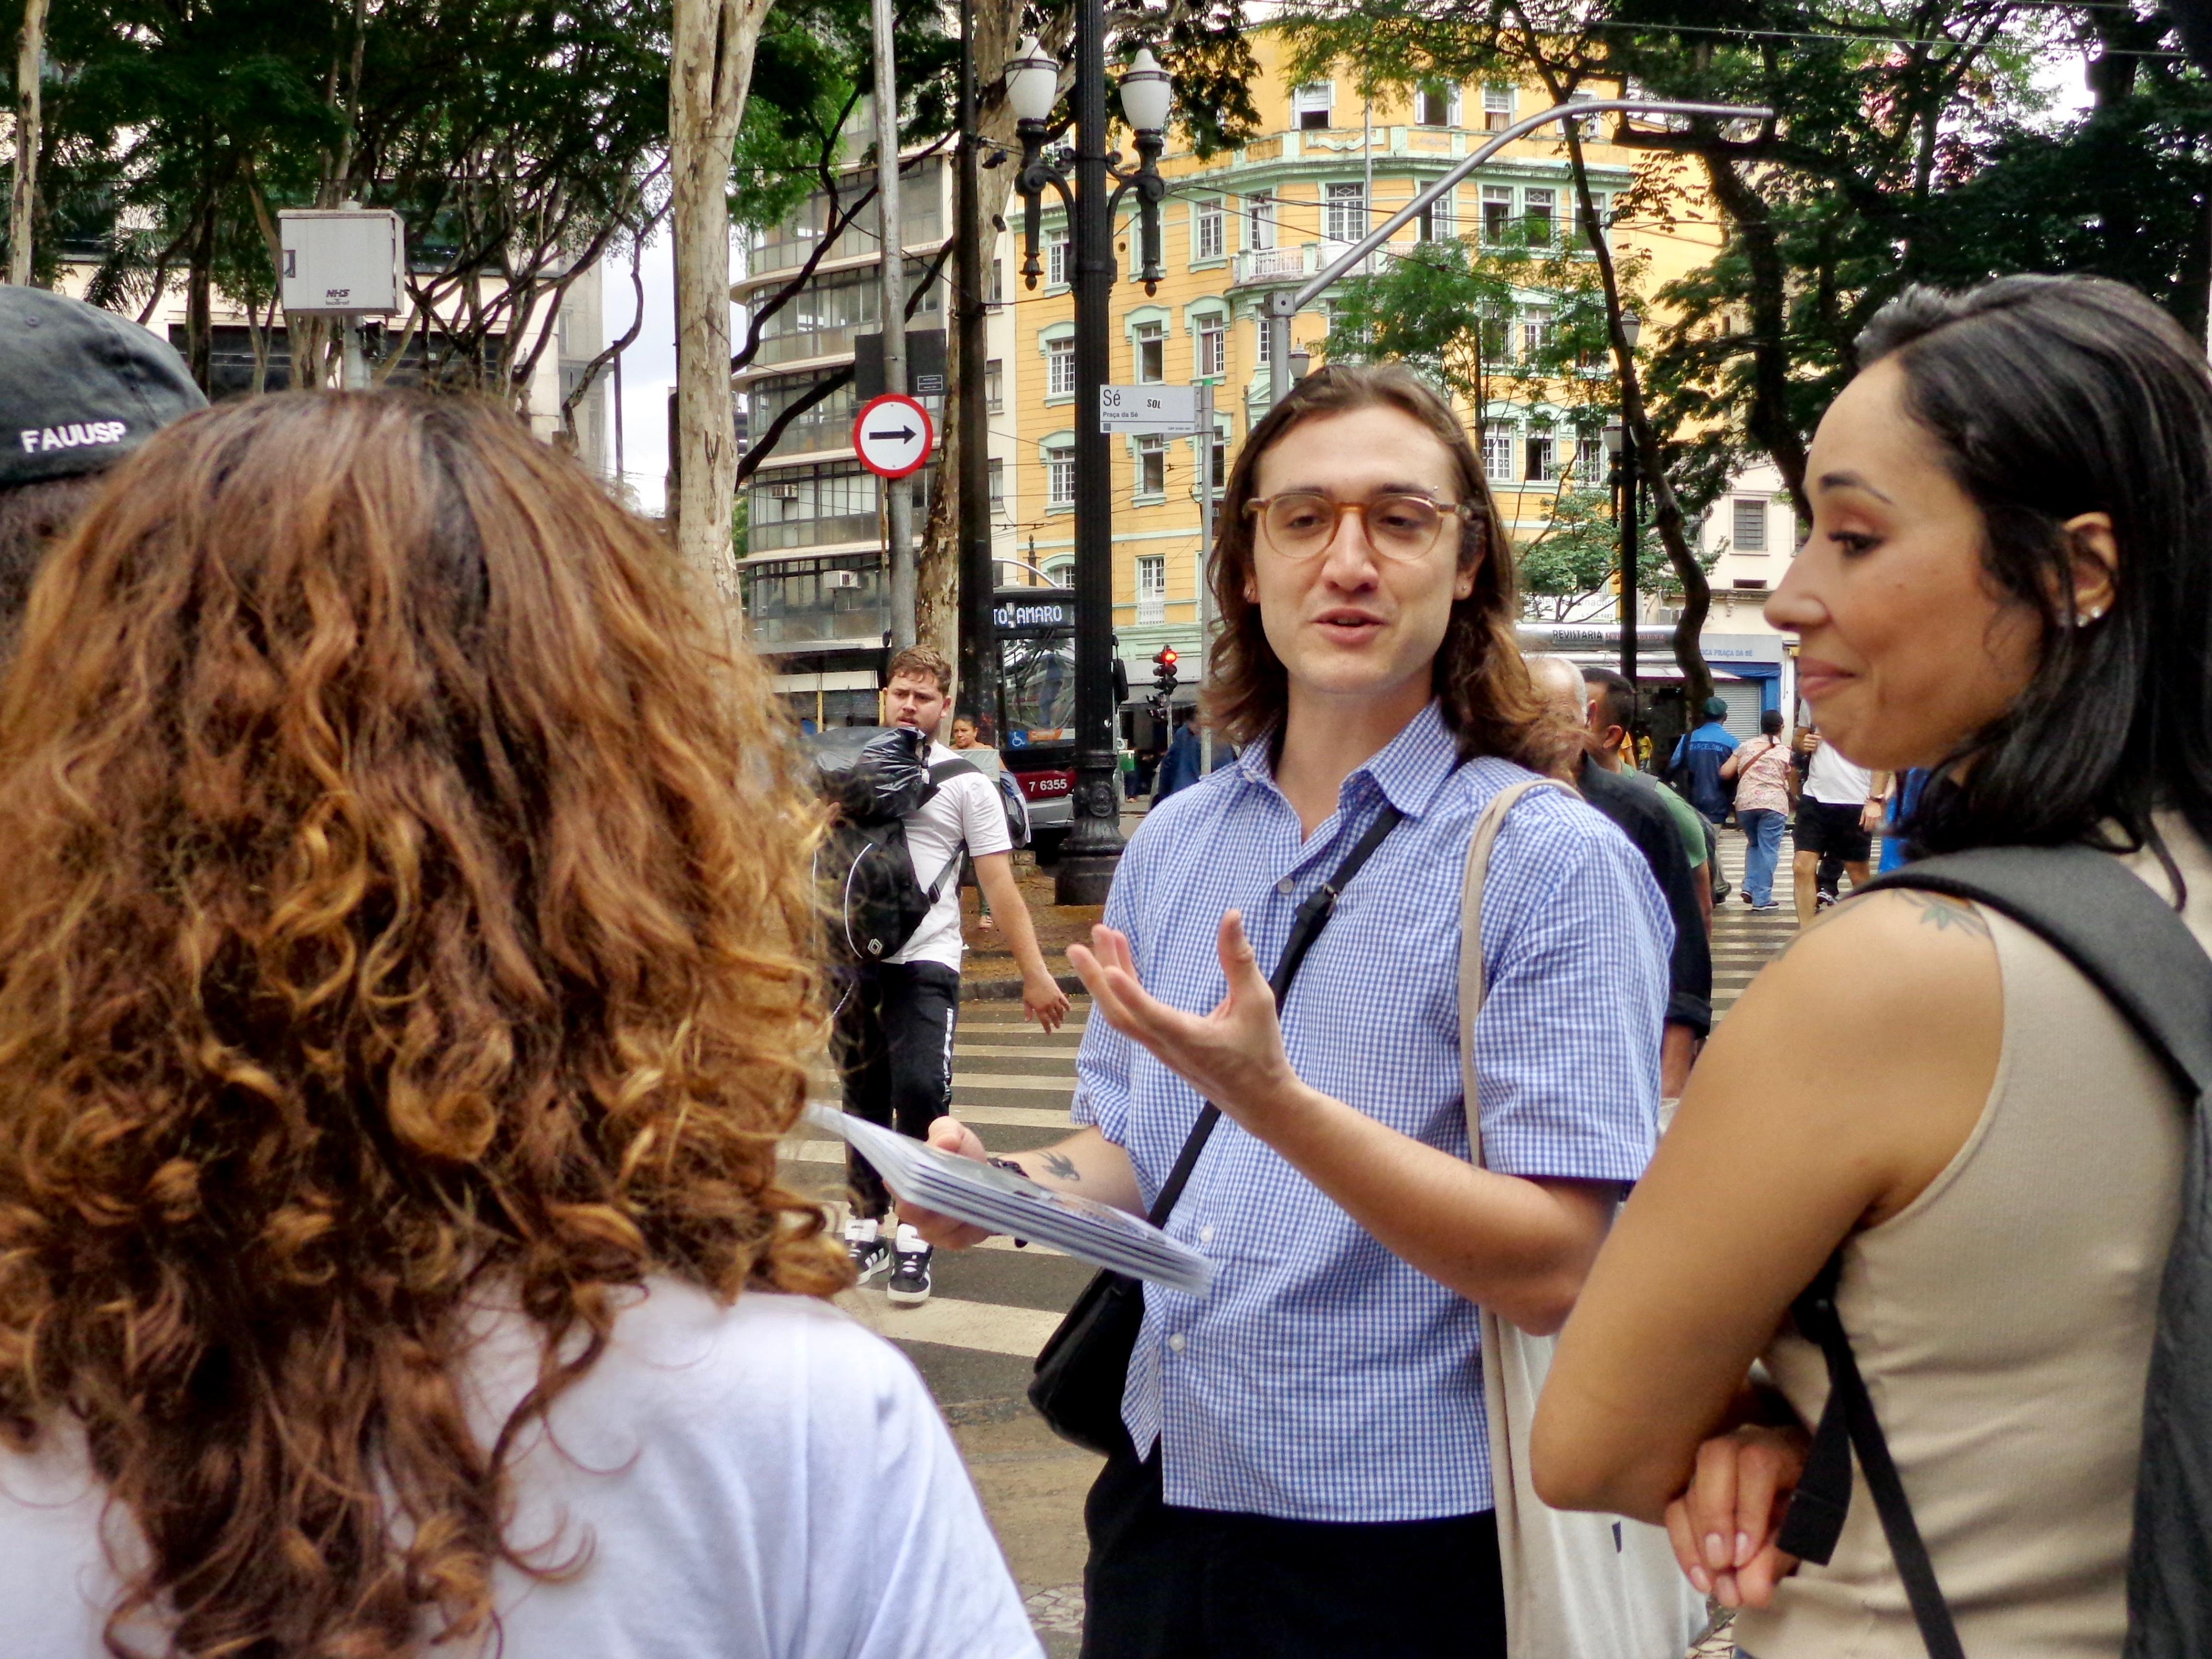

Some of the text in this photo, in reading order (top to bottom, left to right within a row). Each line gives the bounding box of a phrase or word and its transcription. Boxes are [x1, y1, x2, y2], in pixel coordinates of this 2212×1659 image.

[326, 289, 350, 297] NHS
[1103, 389, 1120, 407] Sé
[1147, 399, 1161, 409] SOL
[21, 421, 126, 453] FAUUSP
[1016, 605, 1062, 624] AMARO
[1552, 630, 1602, 640] REVISTARIA
[1029, 779, 1068, 792] 7 6355
